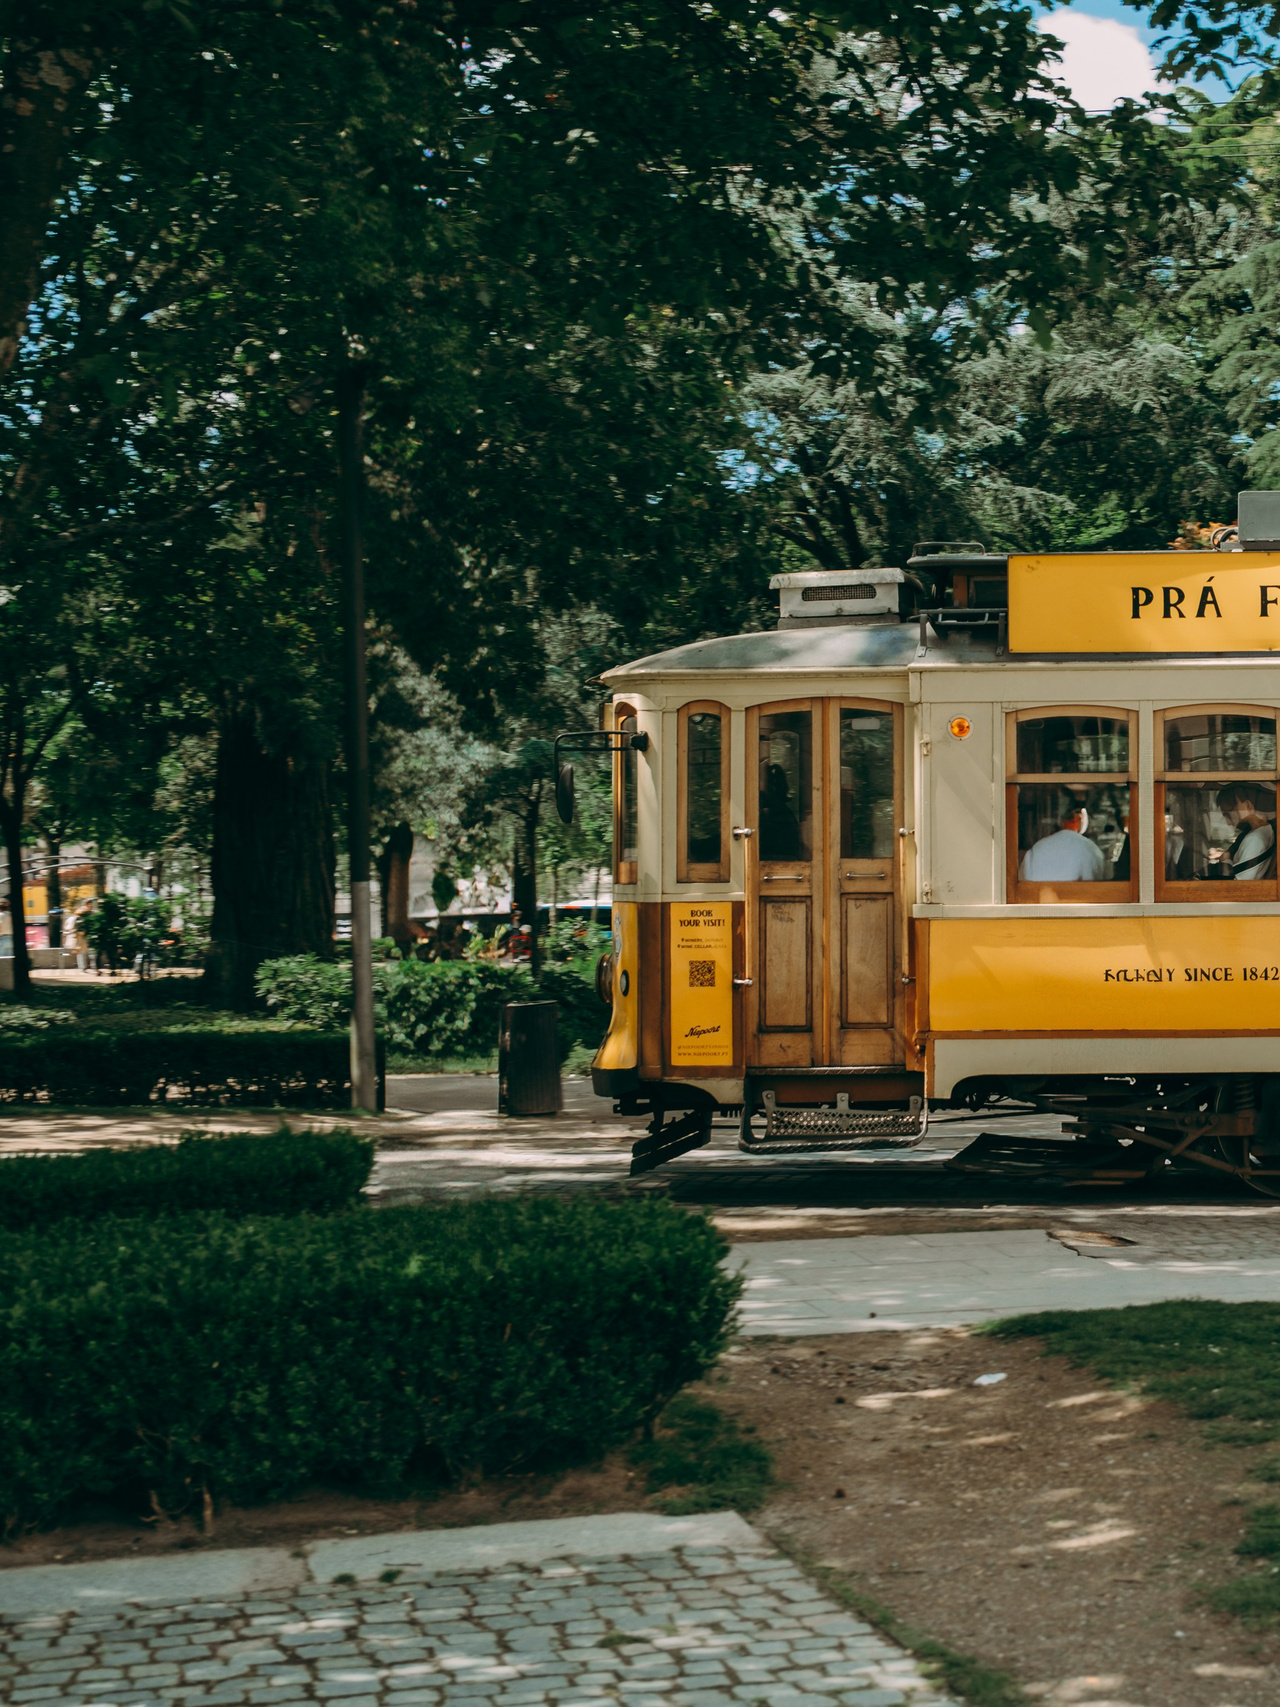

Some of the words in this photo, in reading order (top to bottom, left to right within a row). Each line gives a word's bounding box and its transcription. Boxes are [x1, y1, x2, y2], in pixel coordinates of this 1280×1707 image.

[1130, 575, 1222, 619] PRÁ
[690, 909, 713, 917] BOOK
[679, 919, 700, 927] YOUR
[703, 919, 725, 927] VISIT!
[1184, 967, 1234, 982] SINCE
[1242, 966, 1280, 981] 1842
[684, 1024, 721, 1038] Niepoort
